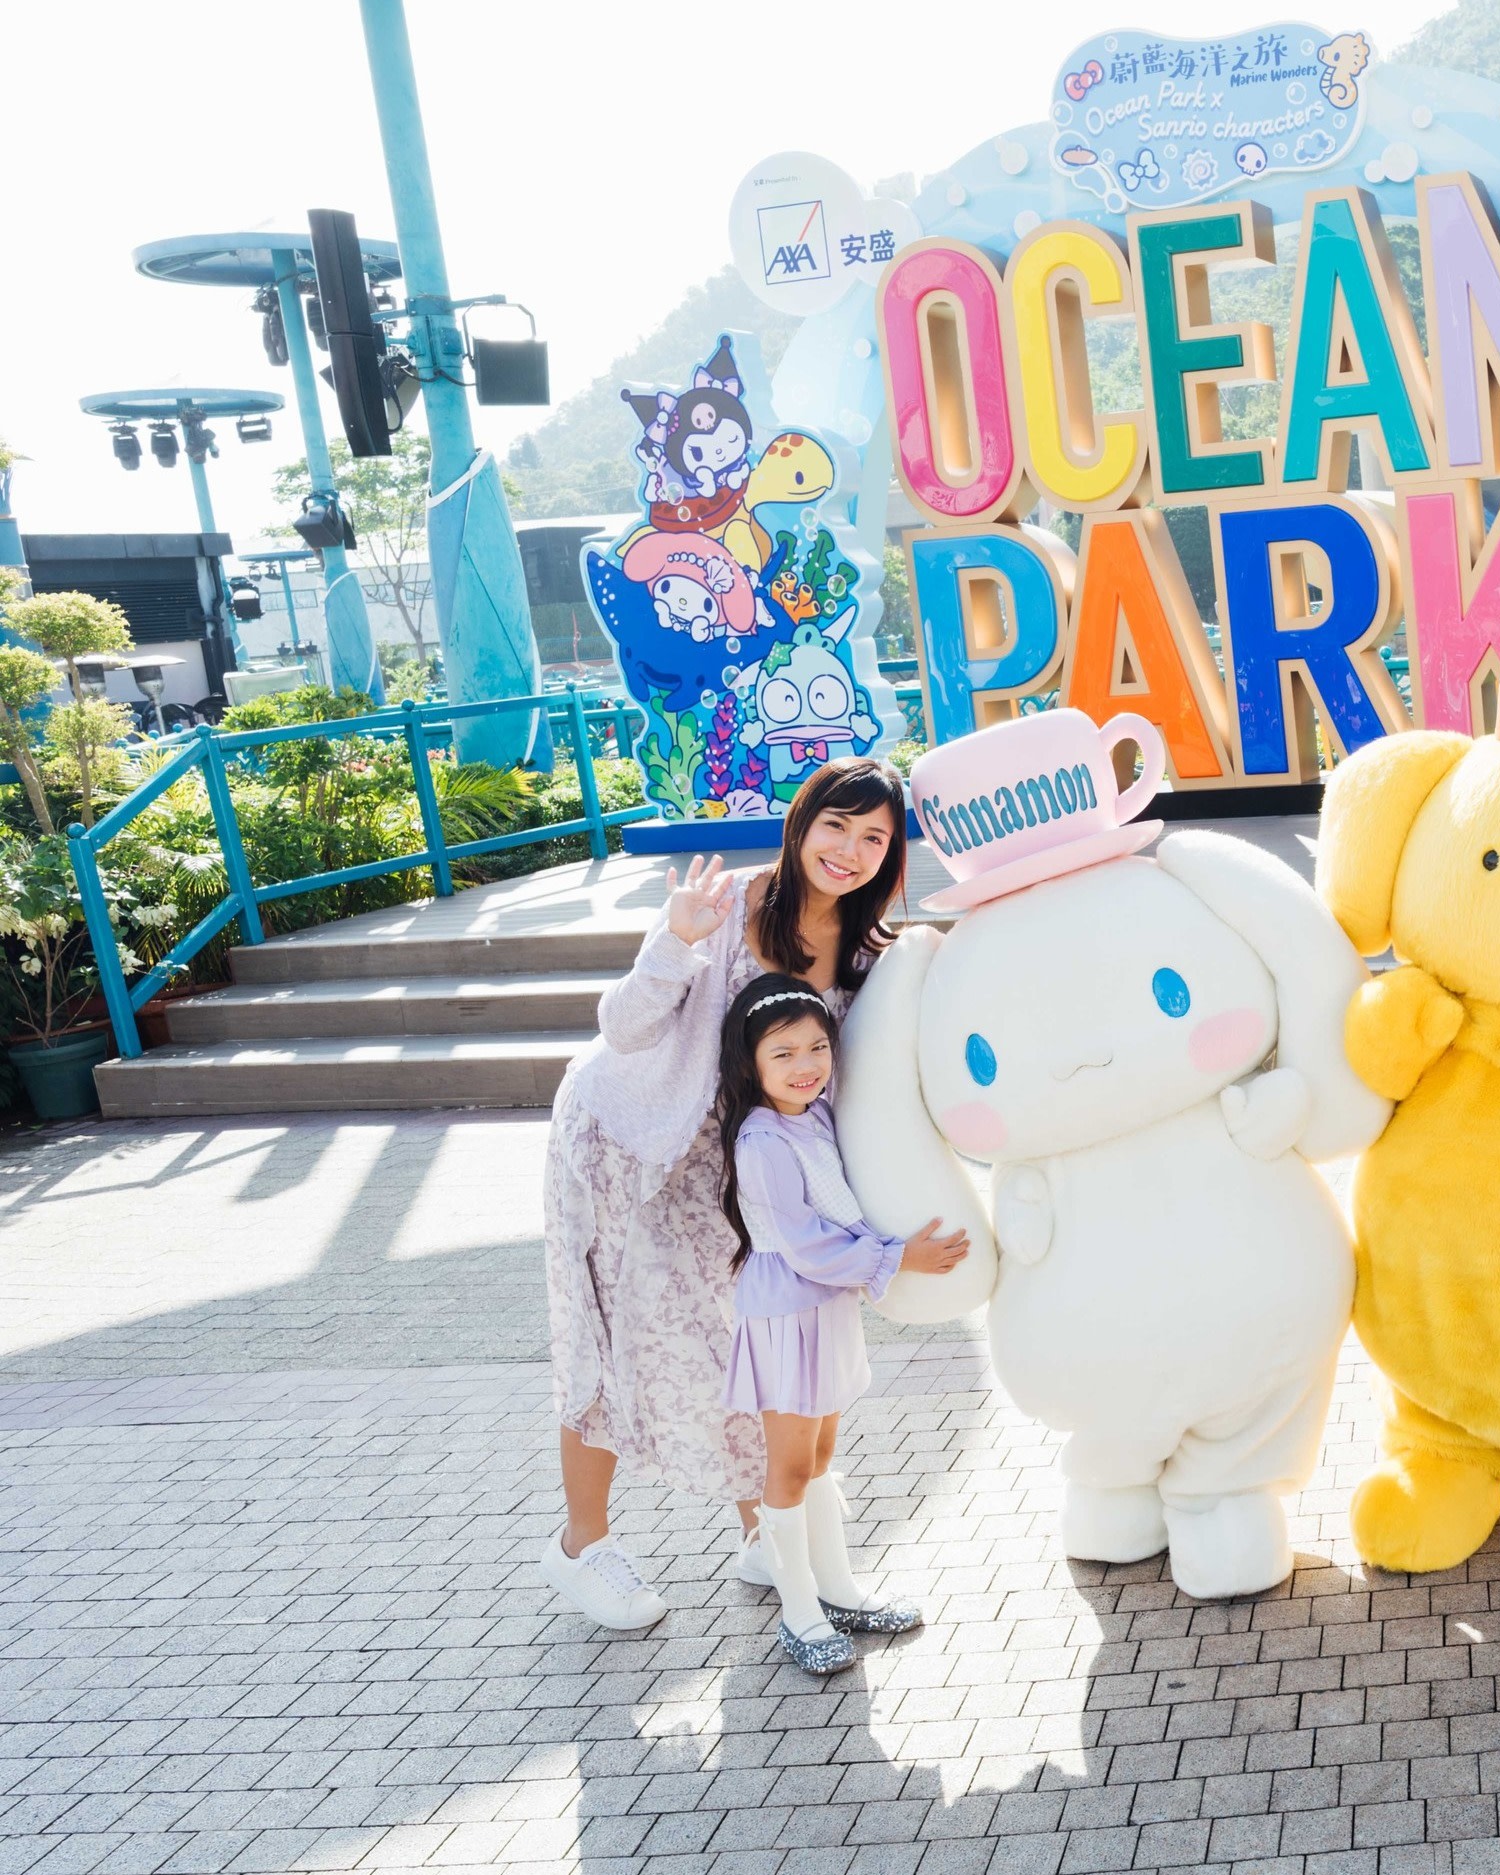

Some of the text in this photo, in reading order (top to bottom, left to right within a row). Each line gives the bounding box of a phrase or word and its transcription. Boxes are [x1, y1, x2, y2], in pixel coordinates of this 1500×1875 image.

[1108, 33, 1288, 84] 蔚藍海洋之旅
[1230, 64, 1318, 87] Marine Wonders
[1085, 91, 1151, 135] Ocean
[1156, 80, 1205, 109] Park
[1137, 100, 1325, 142] Sanrio characters
[766, 243, 818, 276] AXA
[840, 229, 896, 266] 安盛
[922, 763, 1098, 858] Cinnamon
